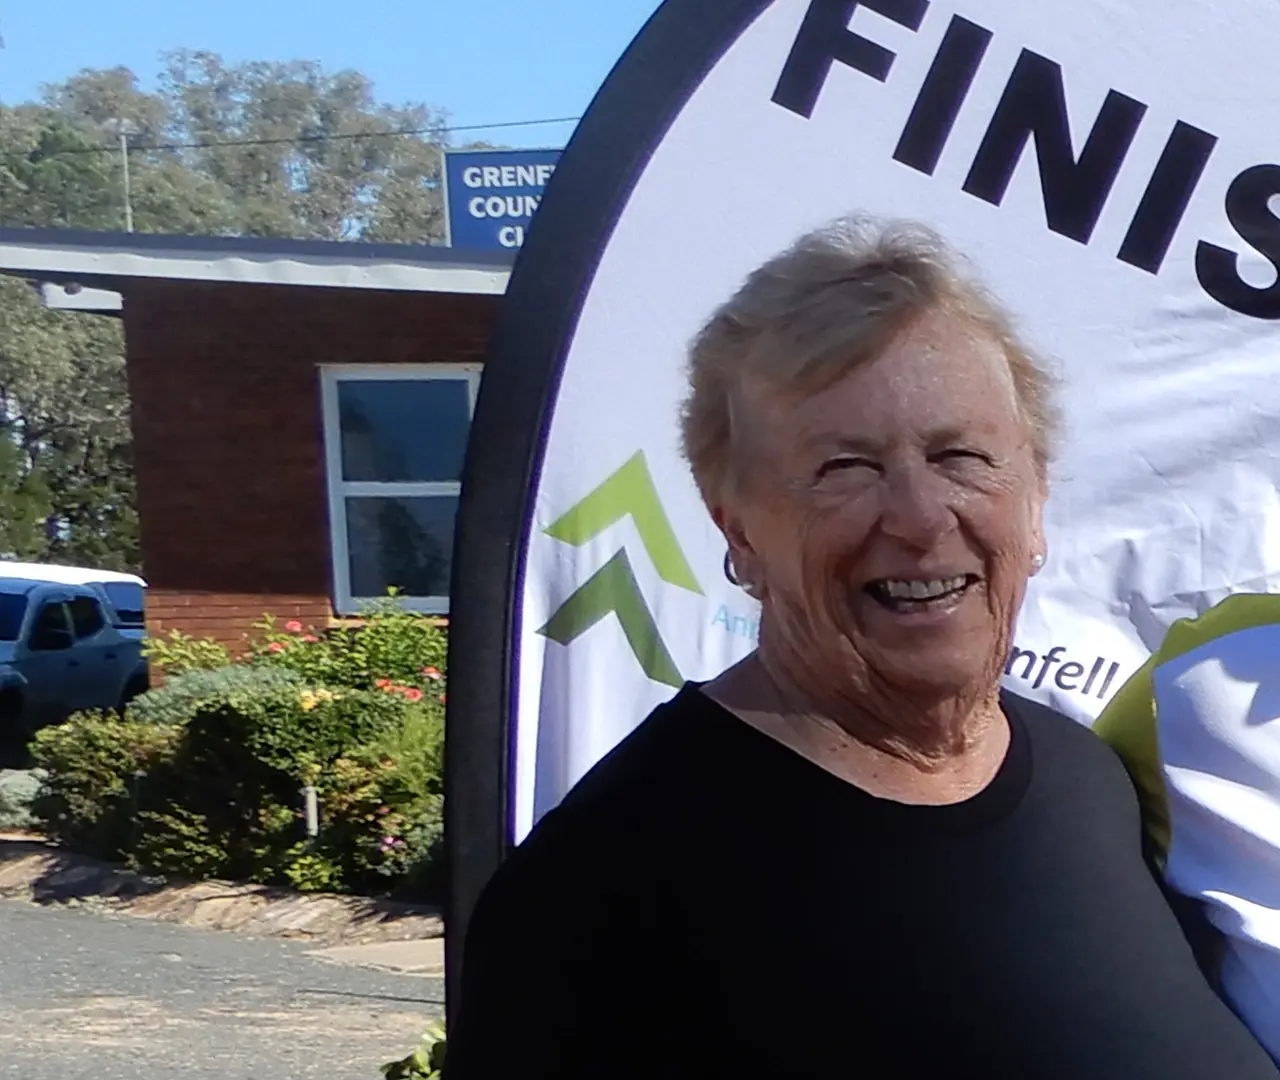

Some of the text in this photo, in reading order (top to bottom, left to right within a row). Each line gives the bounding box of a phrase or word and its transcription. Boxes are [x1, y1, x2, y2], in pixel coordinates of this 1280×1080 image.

[463, 164, 557, 188] GRENF
[468, 196, 543, 218] COUN
[1004, 646, 1120, 699] nfell
